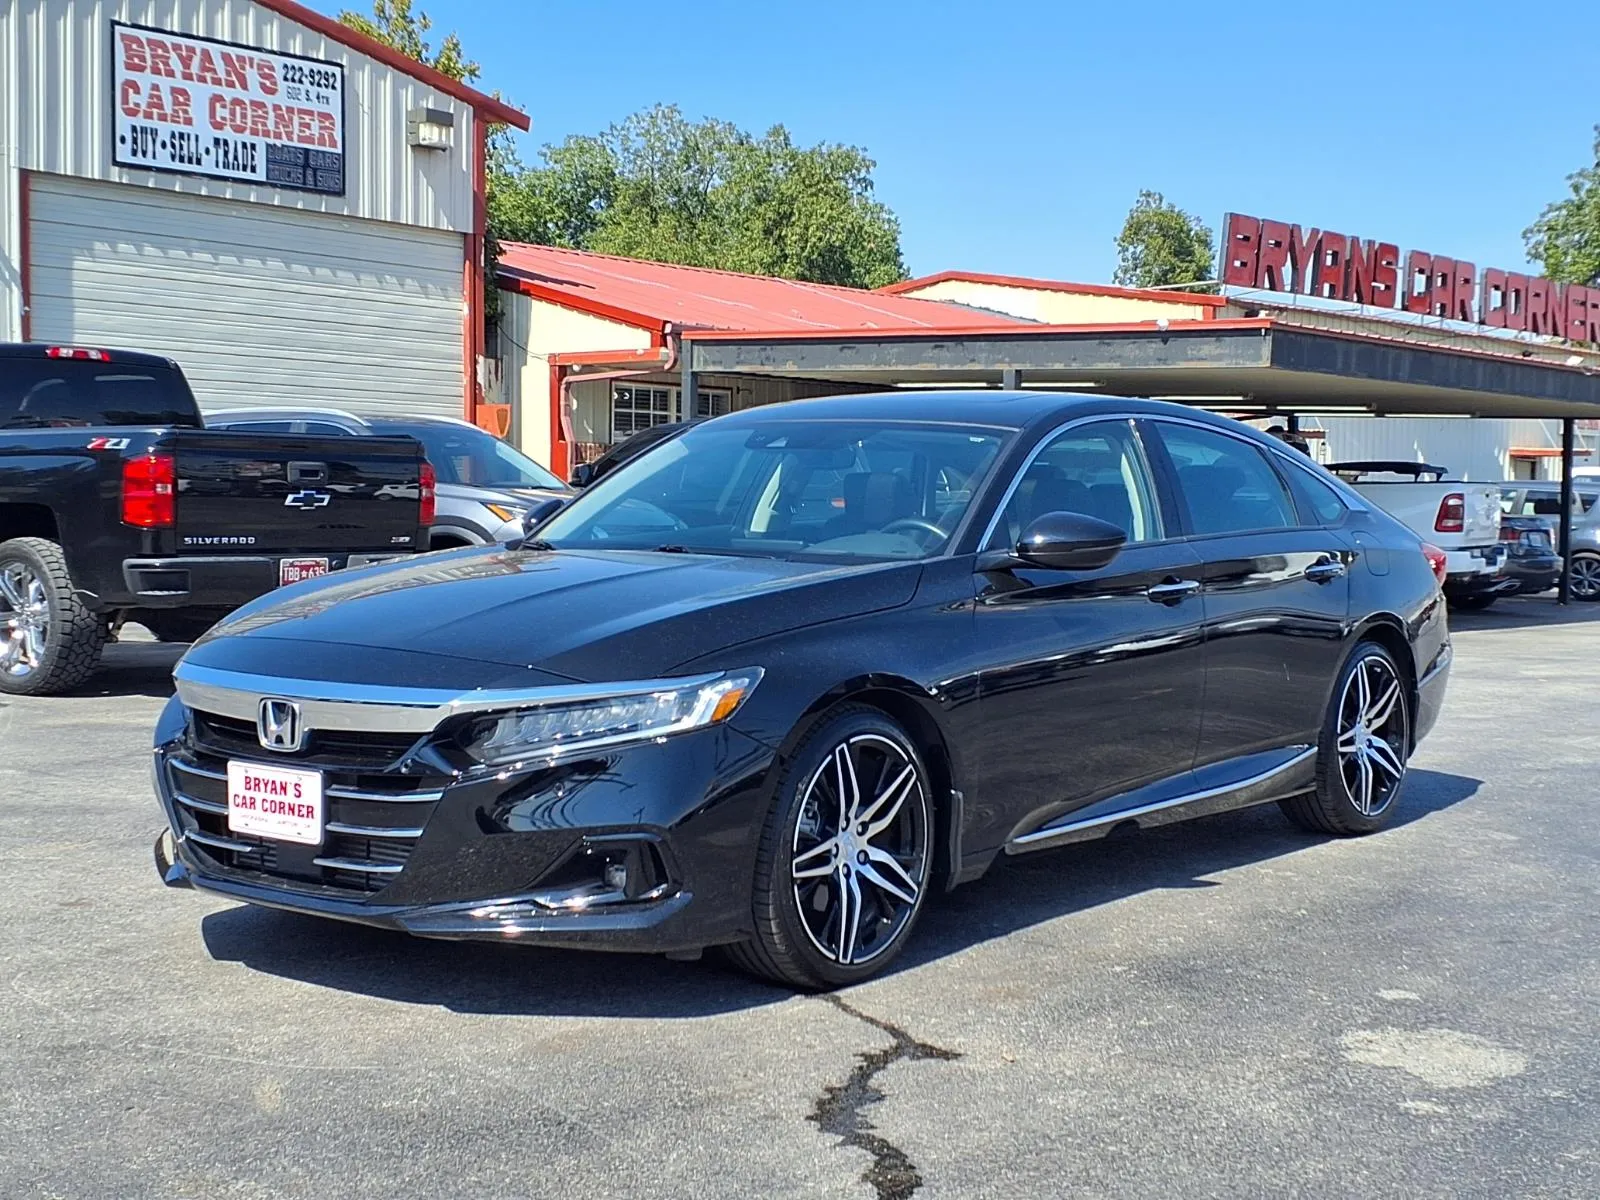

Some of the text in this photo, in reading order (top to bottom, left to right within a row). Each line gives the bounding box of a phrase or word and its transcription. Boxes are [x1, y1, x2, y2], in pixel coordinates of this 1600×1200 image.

[120, 33, 279, 96] BRYAN'S
[282, 63, 337, 91] 222-9292
[120, 78, 338, 149] CAR CORNER
[1219, 211, 1399, 309] BRYANS
[1403, 249, 1477, 322] CAR
[183, 536, 256, 545] SILVERADO
[244, 775, 302, 798] BRYAN'S
[233, 794, 315, 819] CAR CORNER
